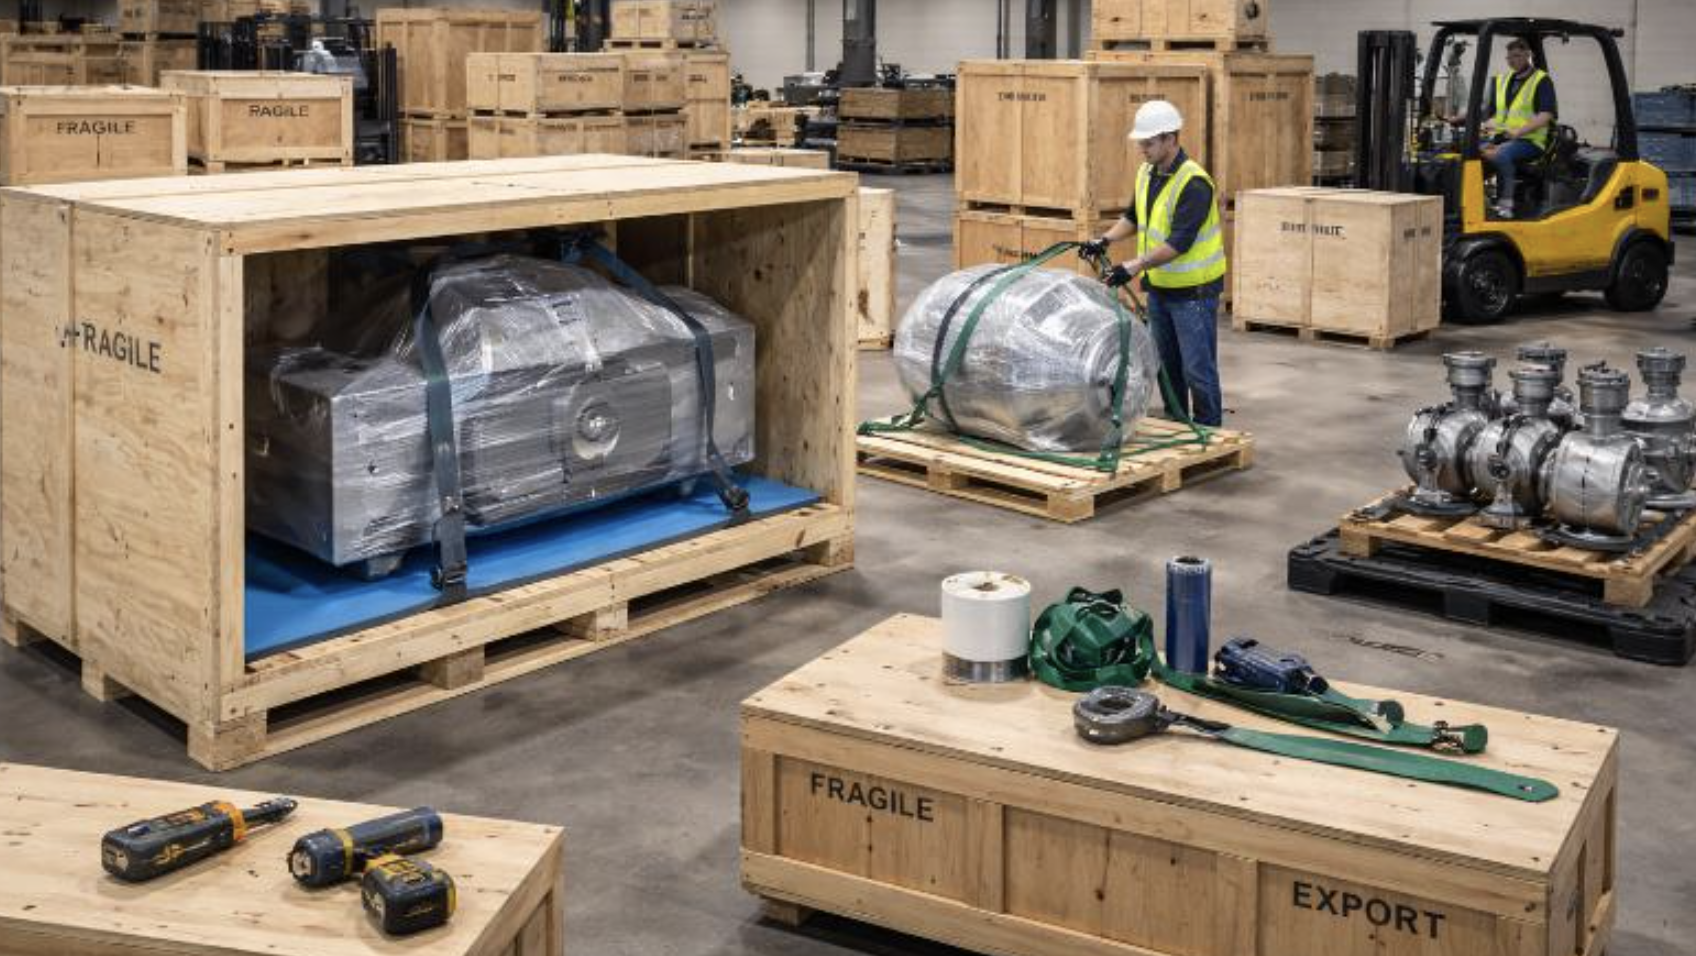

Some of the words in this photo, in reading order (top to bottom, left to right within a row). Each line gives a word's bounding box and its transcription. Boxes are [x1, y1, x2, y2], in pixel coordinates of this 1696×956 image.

[56, 120, 136, 135] FRAGILE
[811, 772, 935, 823] FRAGILE
[1293, 880, 1447, 939] EXPORT
